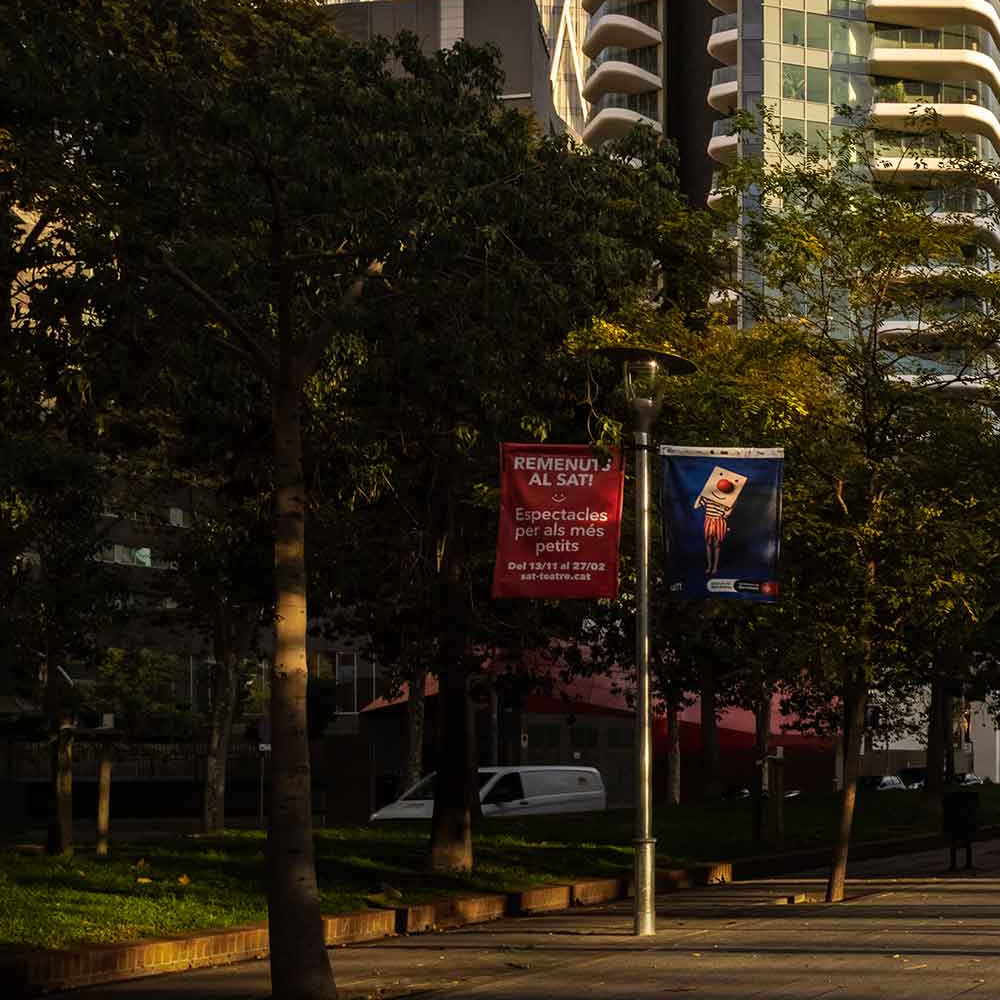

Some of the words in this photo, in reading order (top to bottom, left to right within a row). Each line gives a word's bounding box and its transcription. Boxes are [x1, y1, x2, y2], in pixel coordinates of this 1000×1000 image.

[528, 473, 552, 487] AL
[556, 473, 594, 487] SAT!
[515, 506, 608, 525] Espectacles
[515, 527, 541, 541] per
[543, 521, 566, 537] als
[570, 523, 605, 537] més
[536, 539, 580, 557] petits
[507, 561, 527, 571] Del
[528, 561, 558, 571] 13/11
[560, 561, 570, 571] al
[572, 561, 606, 572] 27/02
